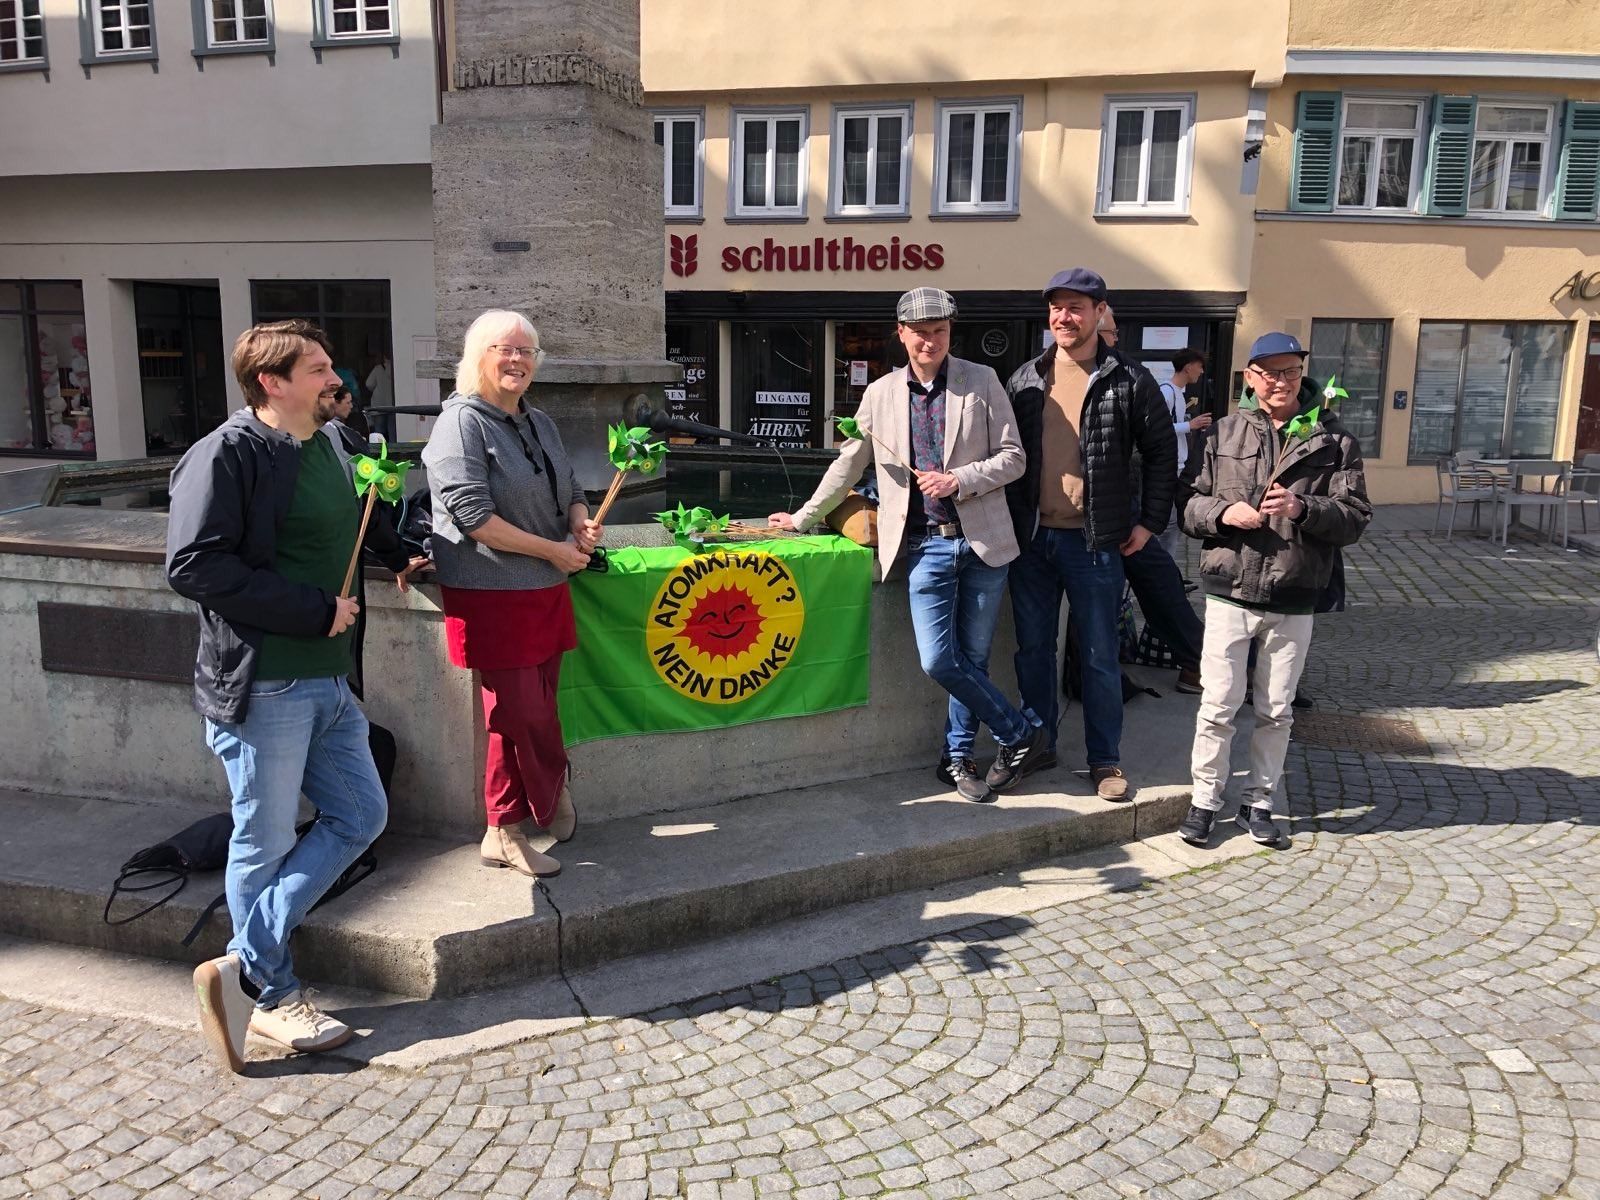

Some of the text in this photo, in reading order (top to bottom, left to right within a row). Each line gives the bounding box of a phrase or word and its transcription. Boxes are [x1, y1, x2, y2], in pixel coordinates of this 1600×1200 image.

[721, 236, 945, 272] schultheiss
[669, 355, 706, 363] SCHÖNSTEN
[683, 368, 706, 384] ge
[757, 393, 809, 403] EINGANG
[797, 408, 810, 416] für
[747, 417, 811, 437] ÄHREN-
[653, 632, 796, 700] NEIN DANKE
